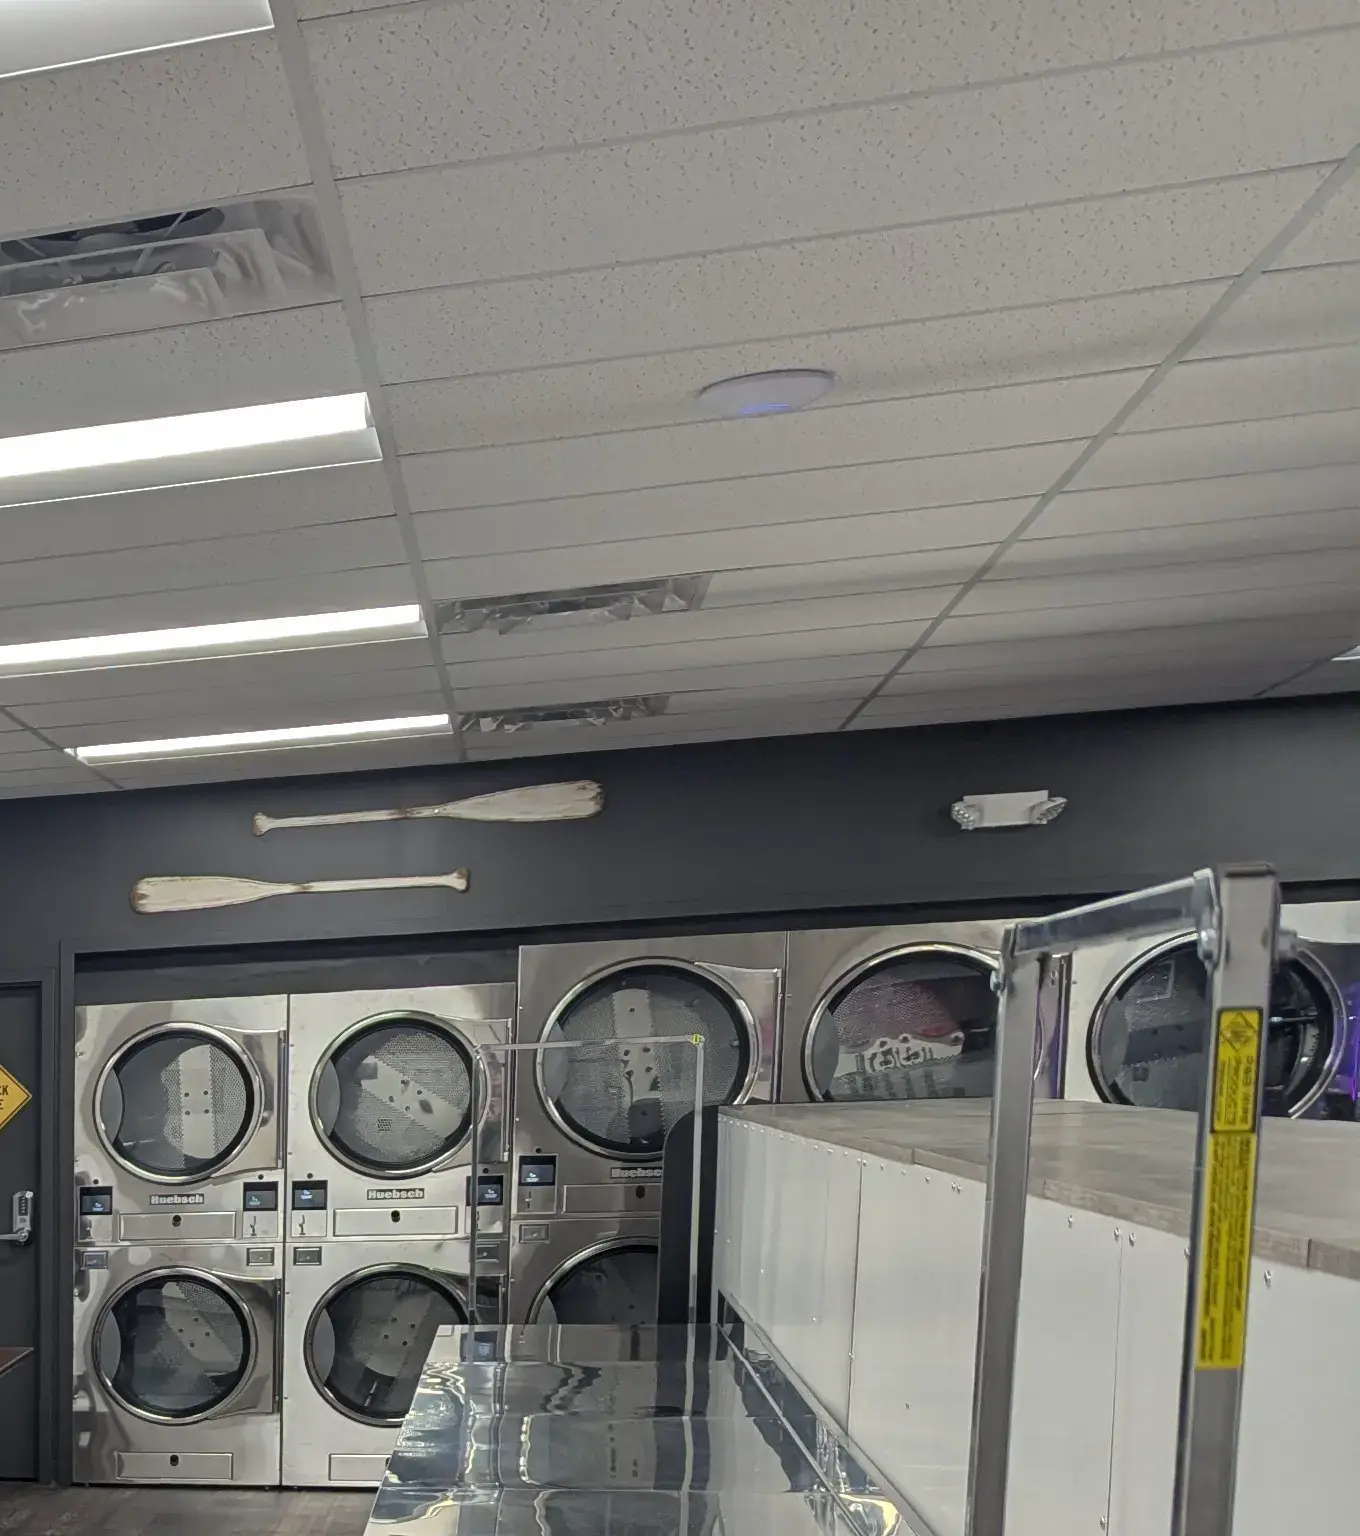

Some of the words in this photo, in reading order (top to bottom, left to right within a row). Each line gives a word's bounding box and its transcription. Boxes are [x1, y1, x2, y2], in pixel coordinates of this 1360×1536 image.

[611, 1168, 662, 1178] Huebsc
[368, 1188, 424, 1199] Huebsch
[150, 1194, 204, 1205] Huebsch
